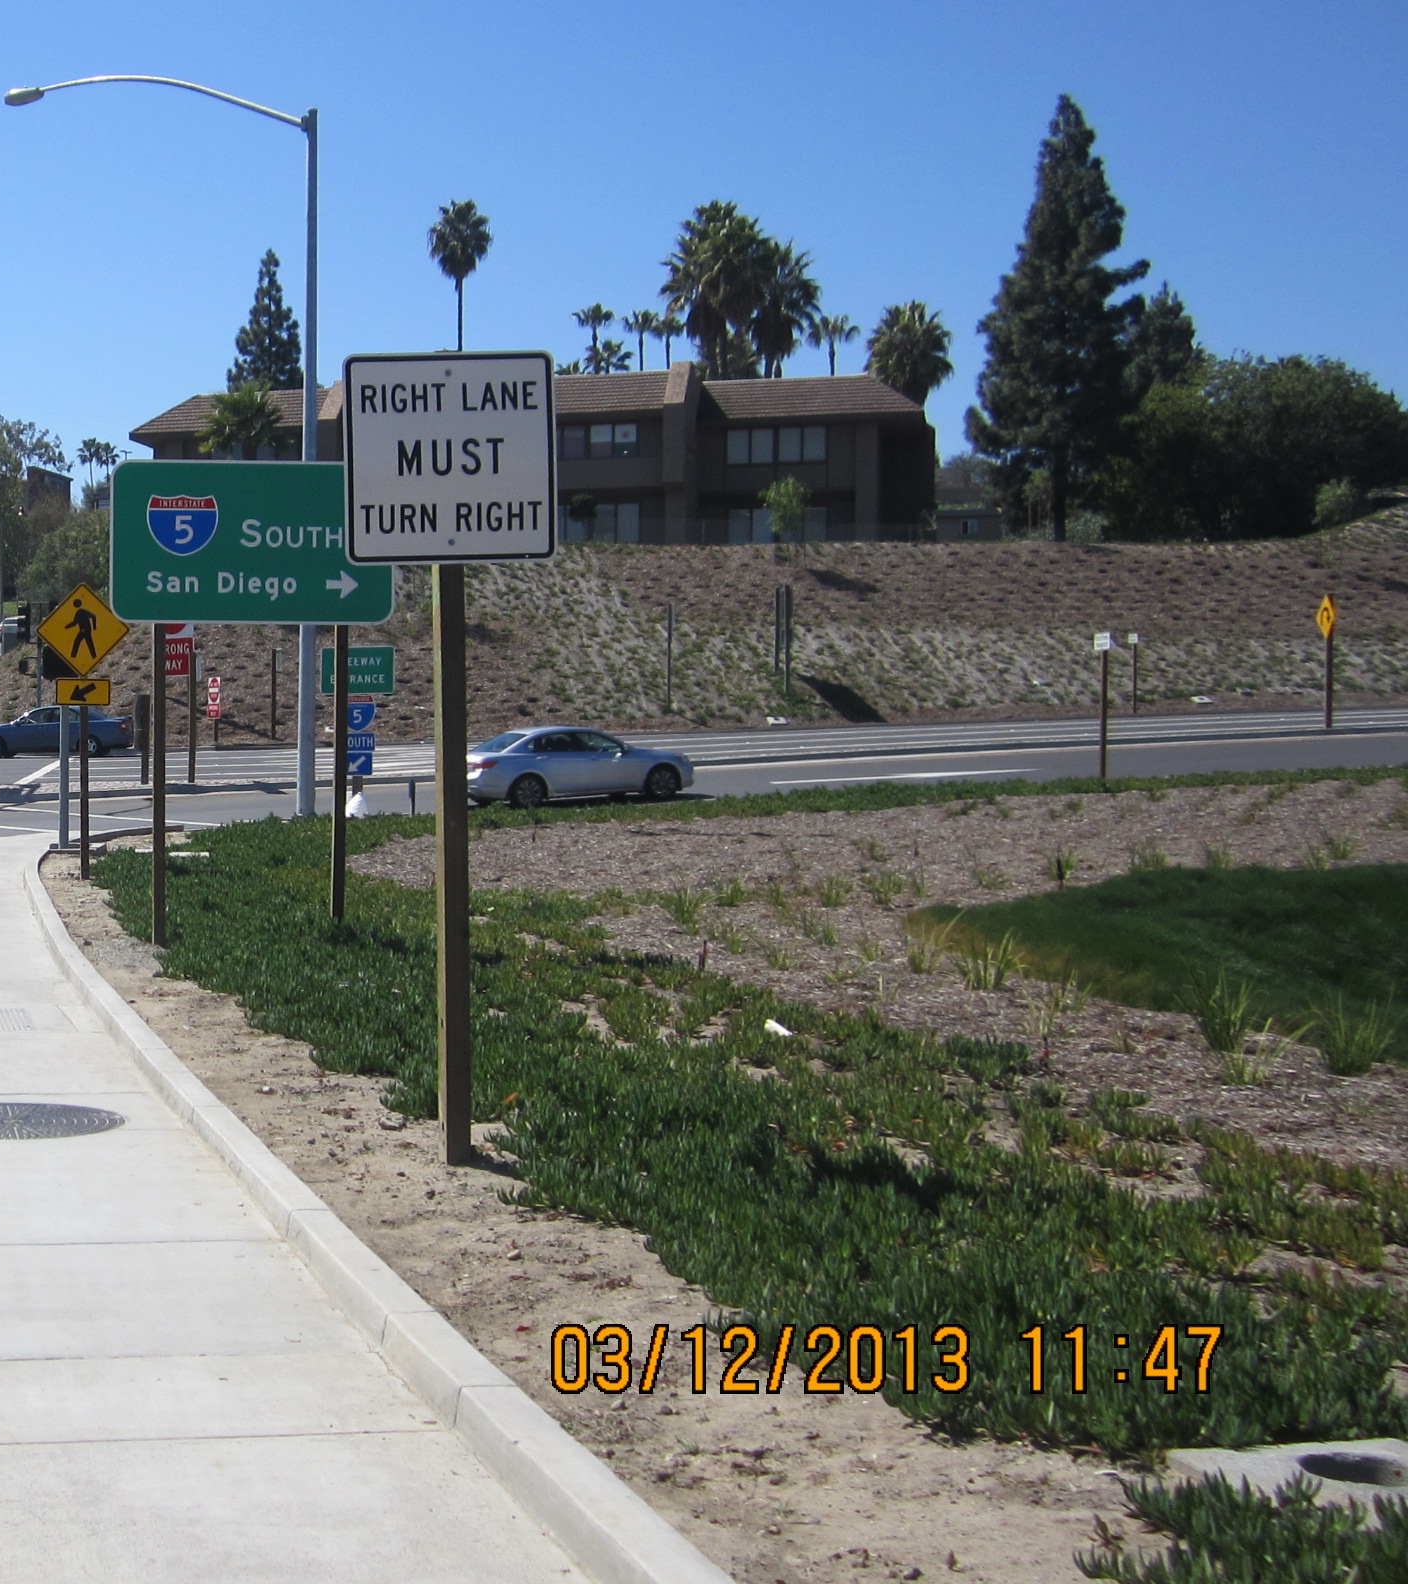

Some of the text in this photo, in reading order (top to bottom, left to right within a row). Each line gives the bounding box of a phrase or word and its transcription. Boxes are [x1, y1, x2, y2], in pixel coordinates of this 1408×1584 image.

[360, 380, 539, 414] RIGHT LANE
[396, 437, 505, 477] MUST
[158, 499, 206, 508] INTERSTATE
[360, 500, 543, 535] TURN RIGHT
[173, 514, 343, 549] 5 SOUTH
[145, 570, 298, 601] San Diego
[165, 643, 190, 655] RONG
[348, 657, 383, 667] EEWAY
[330, 674, 385, 684] ERANCE
[353, 709, 362, 724] 5
[347, 736, 373, 748] OUTH
